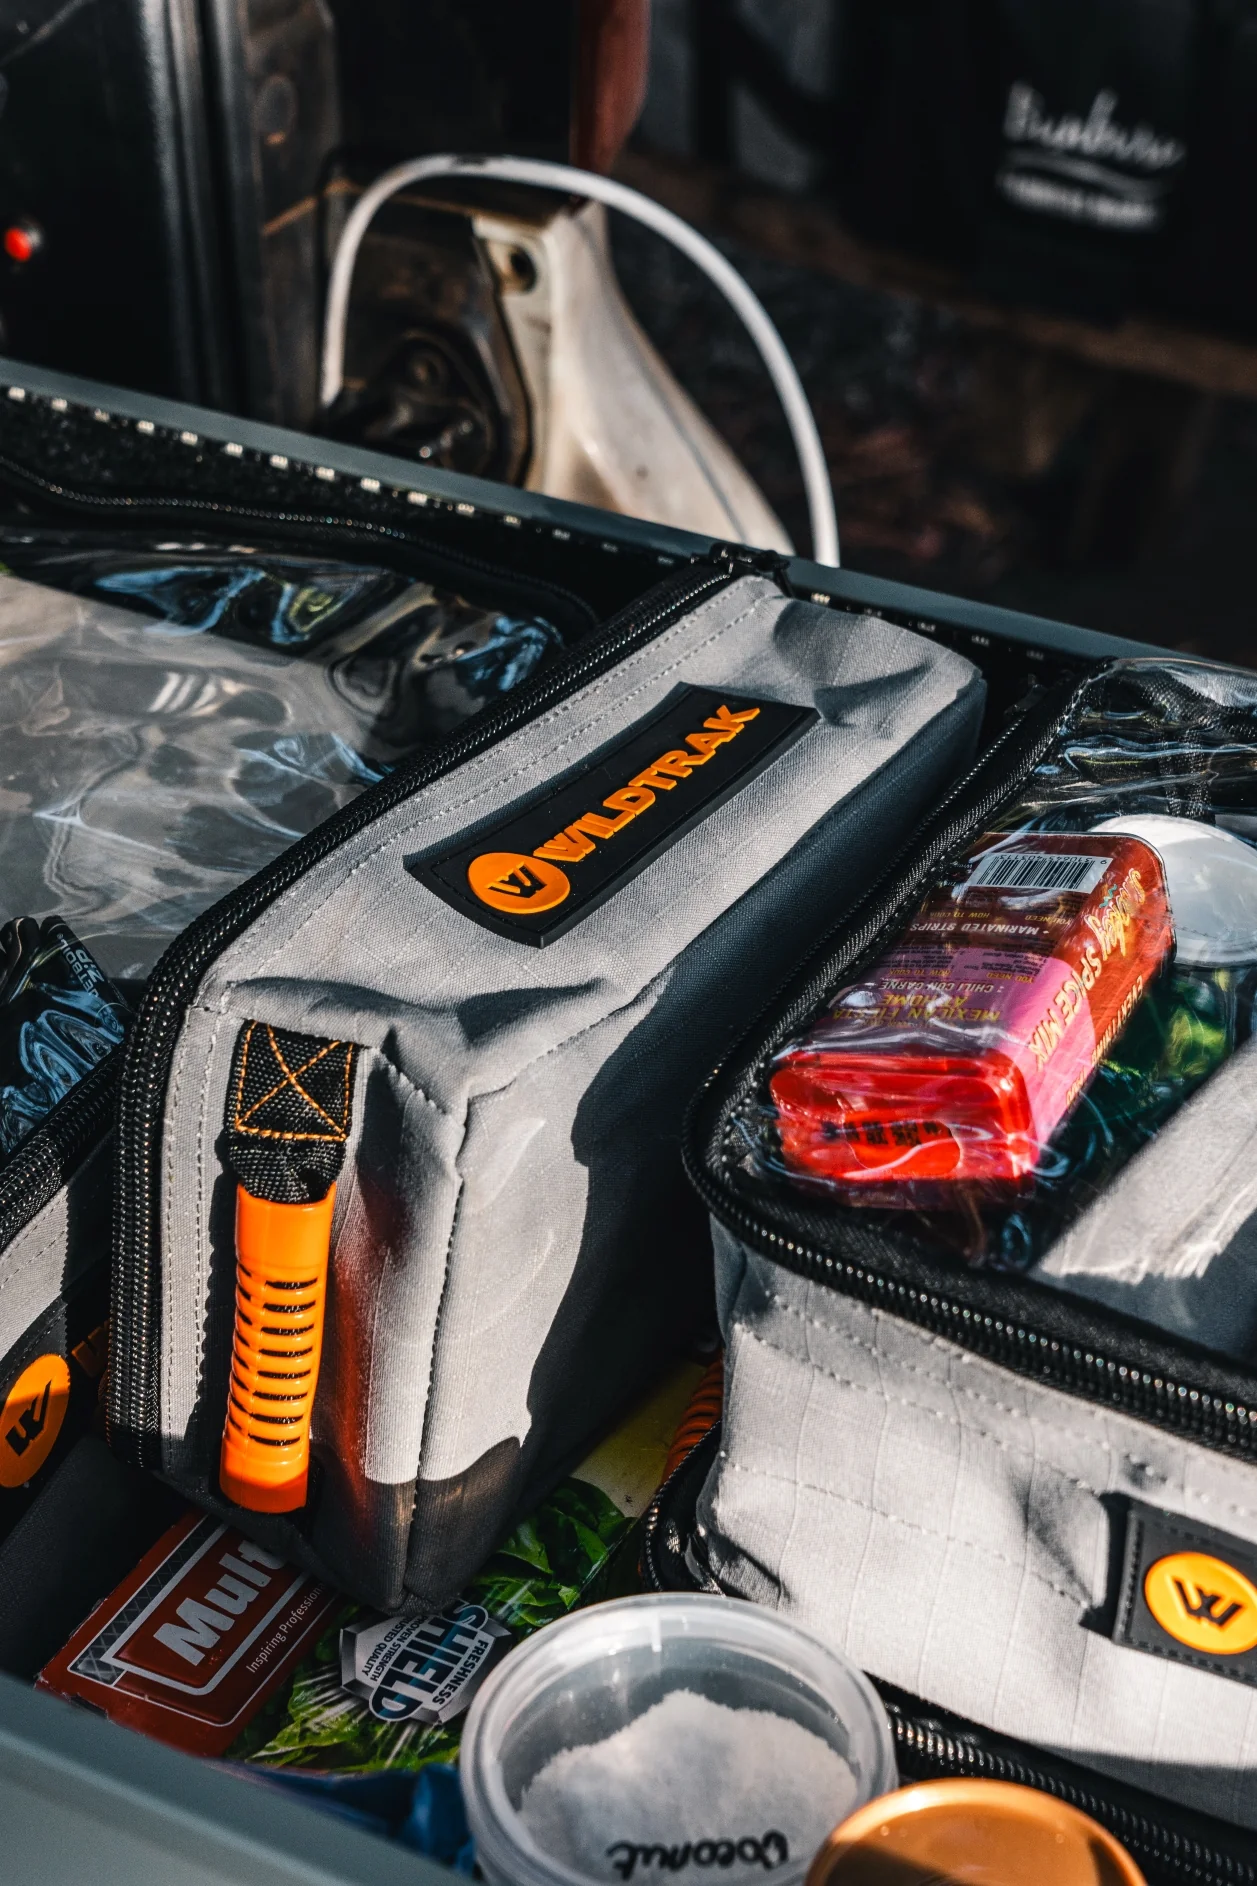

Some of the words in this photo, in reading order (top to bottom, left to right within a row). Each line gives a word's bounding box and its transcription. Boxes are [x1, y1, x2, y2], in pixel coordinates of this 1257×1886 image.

[533, 704, 761, 863] WILDTRAK
[910, 922, 958, 932] STRIPS
[961, 923, 1039, 935] MARINATED
[879, 980, 924, 991] CARNE
[883, 993, 939, 1007] HOME
[926, 981, 955, 992] CON
[957, 981, 994, 993] CHILI
[1054, 945, 1102, 1027] SPICE
[907, 1006, 1000, 1021] MEXICAN
[1028, 1007, 1065, 1073] MIX
[153, 1540, 286, 1667] Mult
[246, 1632, 287, 1673] Inspiring
[278, 1581, 327, 1634] Professiona
[397, 1615, 428, 1645] PROVEN
[361, 1642, 388, 1677] QUALITY
[370, 1600, 488, 1720] SHIELD
[370, 1643, 401, 1682] STRENGTH
[432, 1639, 490, 1705] FRESHNESS
